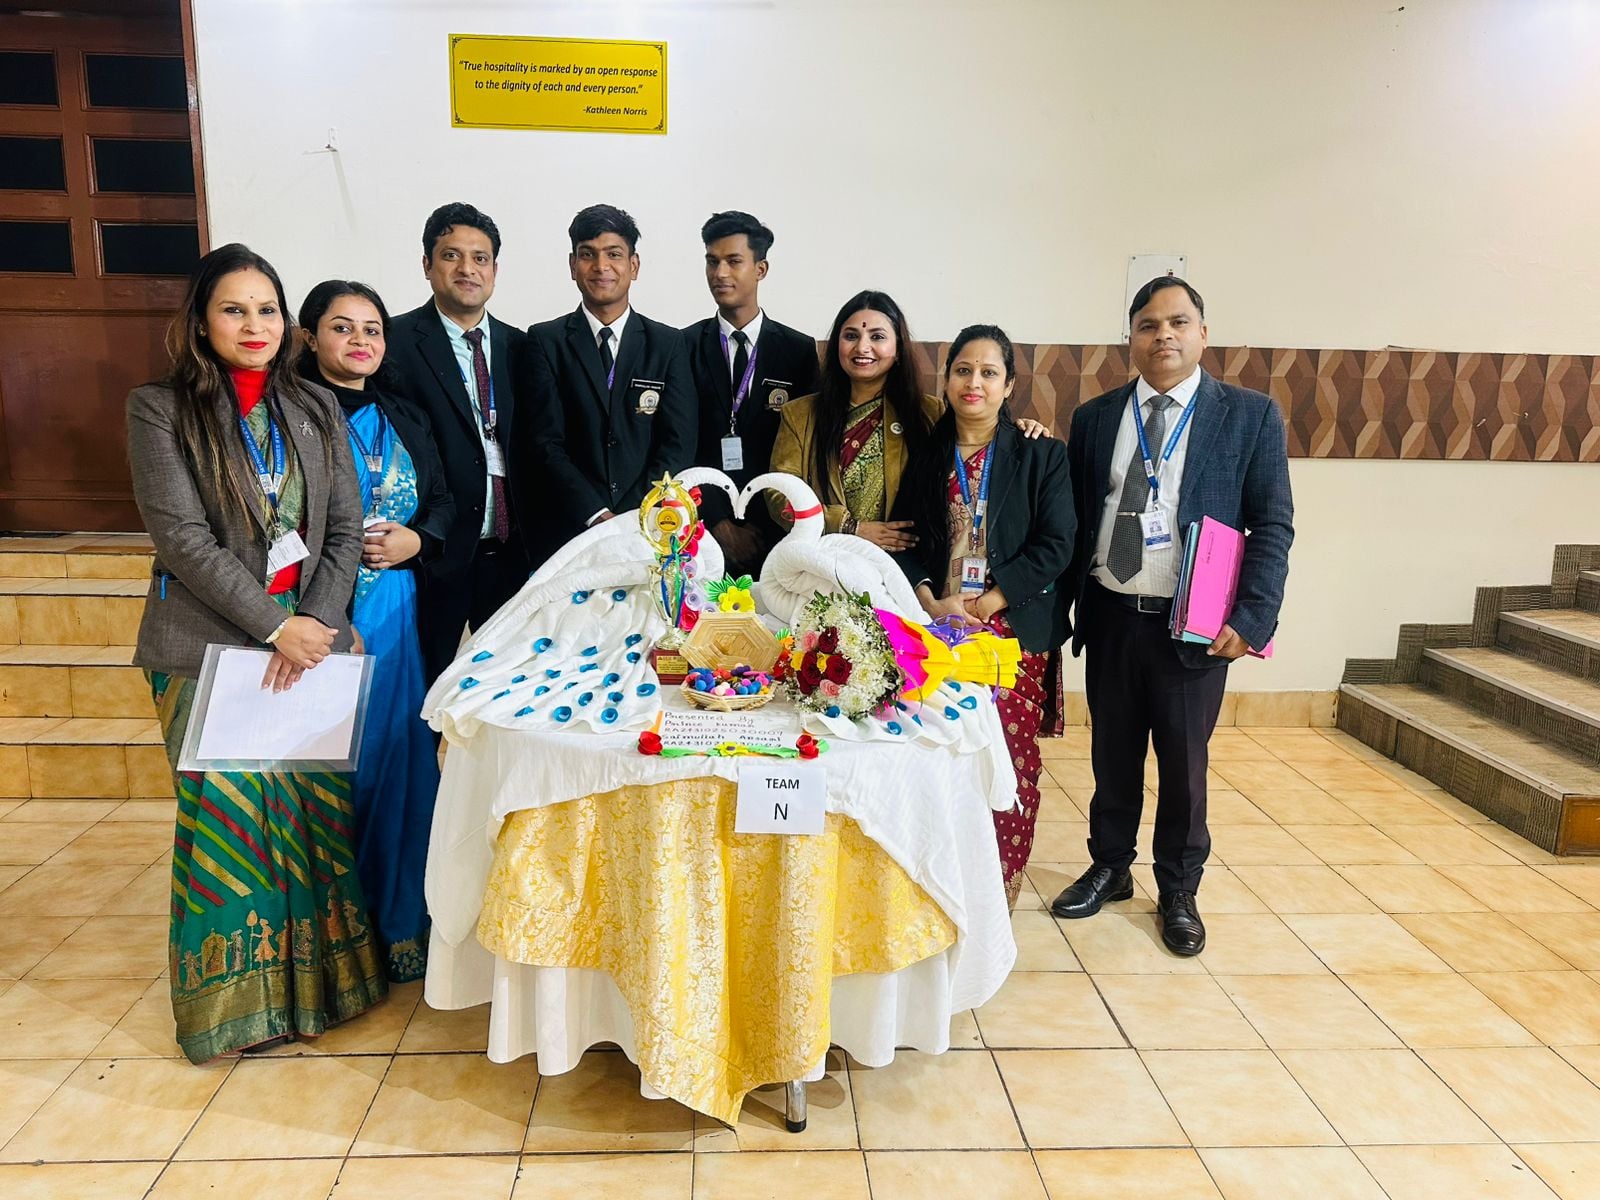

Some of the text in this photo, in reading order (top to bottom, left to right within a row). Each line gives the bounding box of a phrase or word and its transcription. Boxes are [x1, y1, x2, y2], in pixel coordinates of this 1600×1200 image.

[459, 60, 658, 78] “True hospitality is marked by an open response
[475, 80, 484, 89] to
[485, 80, 500, 90] the
[501, 80, 531, 92] dignity
[532, 80, 542, 92] of
[543, 81, 563, 91] each
[565, 82, 582, 92] and
[583, 84, 606, 95] every
[583, 105, 648, 116] -Kathleen Norris
[765, 778, 800, 789] TEAM
[774, 803, 788, 820] N
